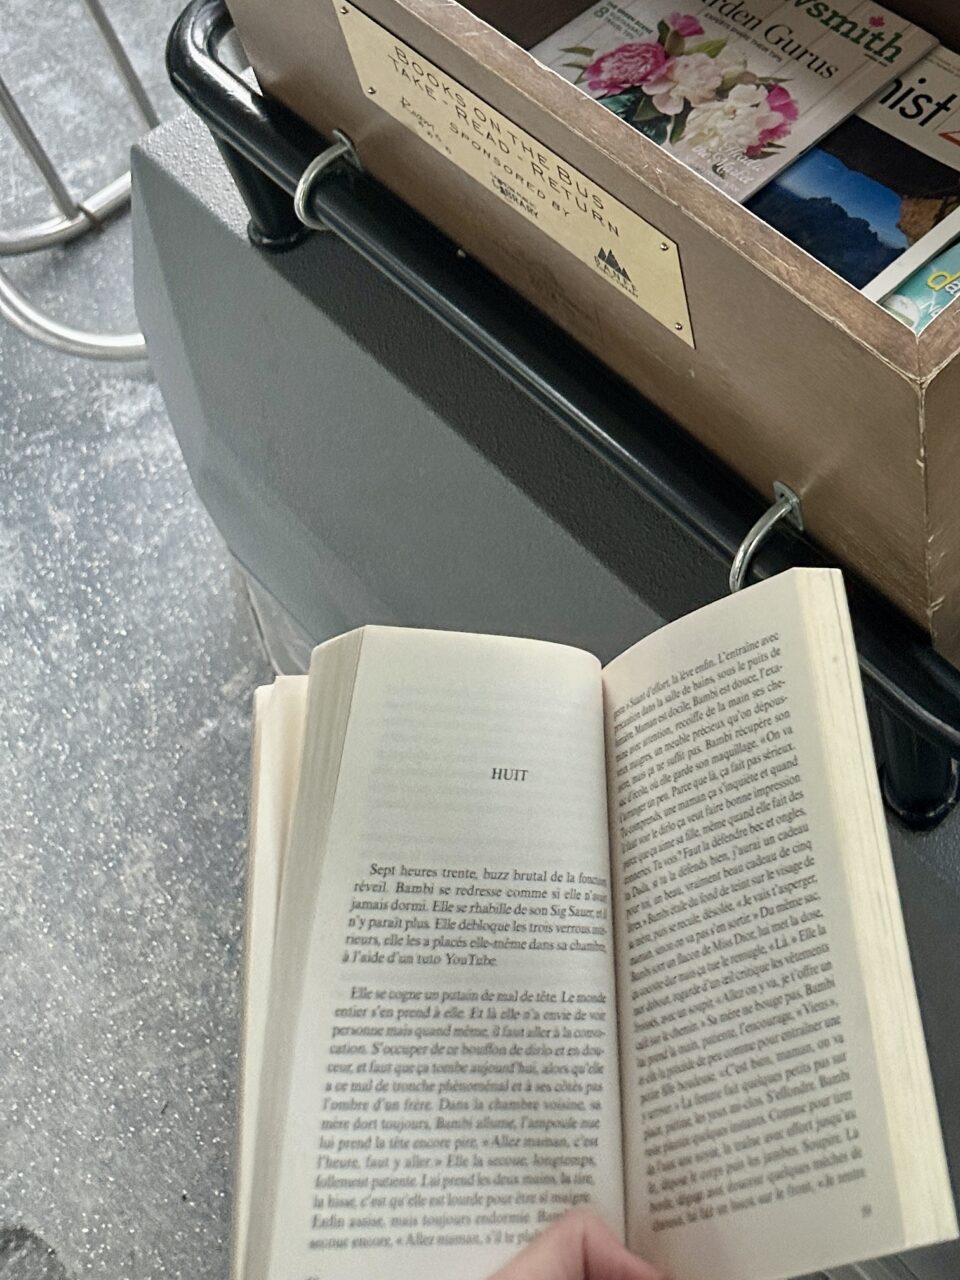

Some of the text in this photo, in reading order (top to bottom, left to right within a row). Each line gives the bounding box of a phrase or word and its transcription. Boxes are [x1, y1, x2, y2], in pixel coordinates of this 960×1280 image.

[593, 6, 609, 18] 8
[764, 24, 839, 79] Gurus
[395, 46, 466, 108] BOOKS
[474, 107, 501, 133] ON
[507, 132, 550, 171] THE
[557, 165, 604, 210] BUS
[388, 54, 436, 101] TAKE
[455, 105, 510, 154] READ
[530, 162, 619, 237] RETURN
[450, 121, 546, 200] SPONSORED
[552, 201, 571, 216] BY
[491, 767, 528, 782] HUIT
[370, 863, 396, 878] Sept
[400, 865, 438, 877] heures
[442, 868, 478, 880] trente,
[483, 868, 509, 879] buzz
[513, 869, 547, 881] brutal
[550, 871, 563, 882] de
[567, 872, 575, 883] la
[396, 882, 434, 894] Bambi
[439, 887, 451, 895] se
[455, 885, 502, 897] redresse
[506, 890, 548, 898] comme
[551, 888, 560, 899] si
[564, 888, 581, 900] elle
[432, 900, 455, 912] Elle
[456, 904, 466, 912] se
[514, 904, 528, 915] de
[529, 907, 548, 916] son
[551, 905, 566, 919] Sig
